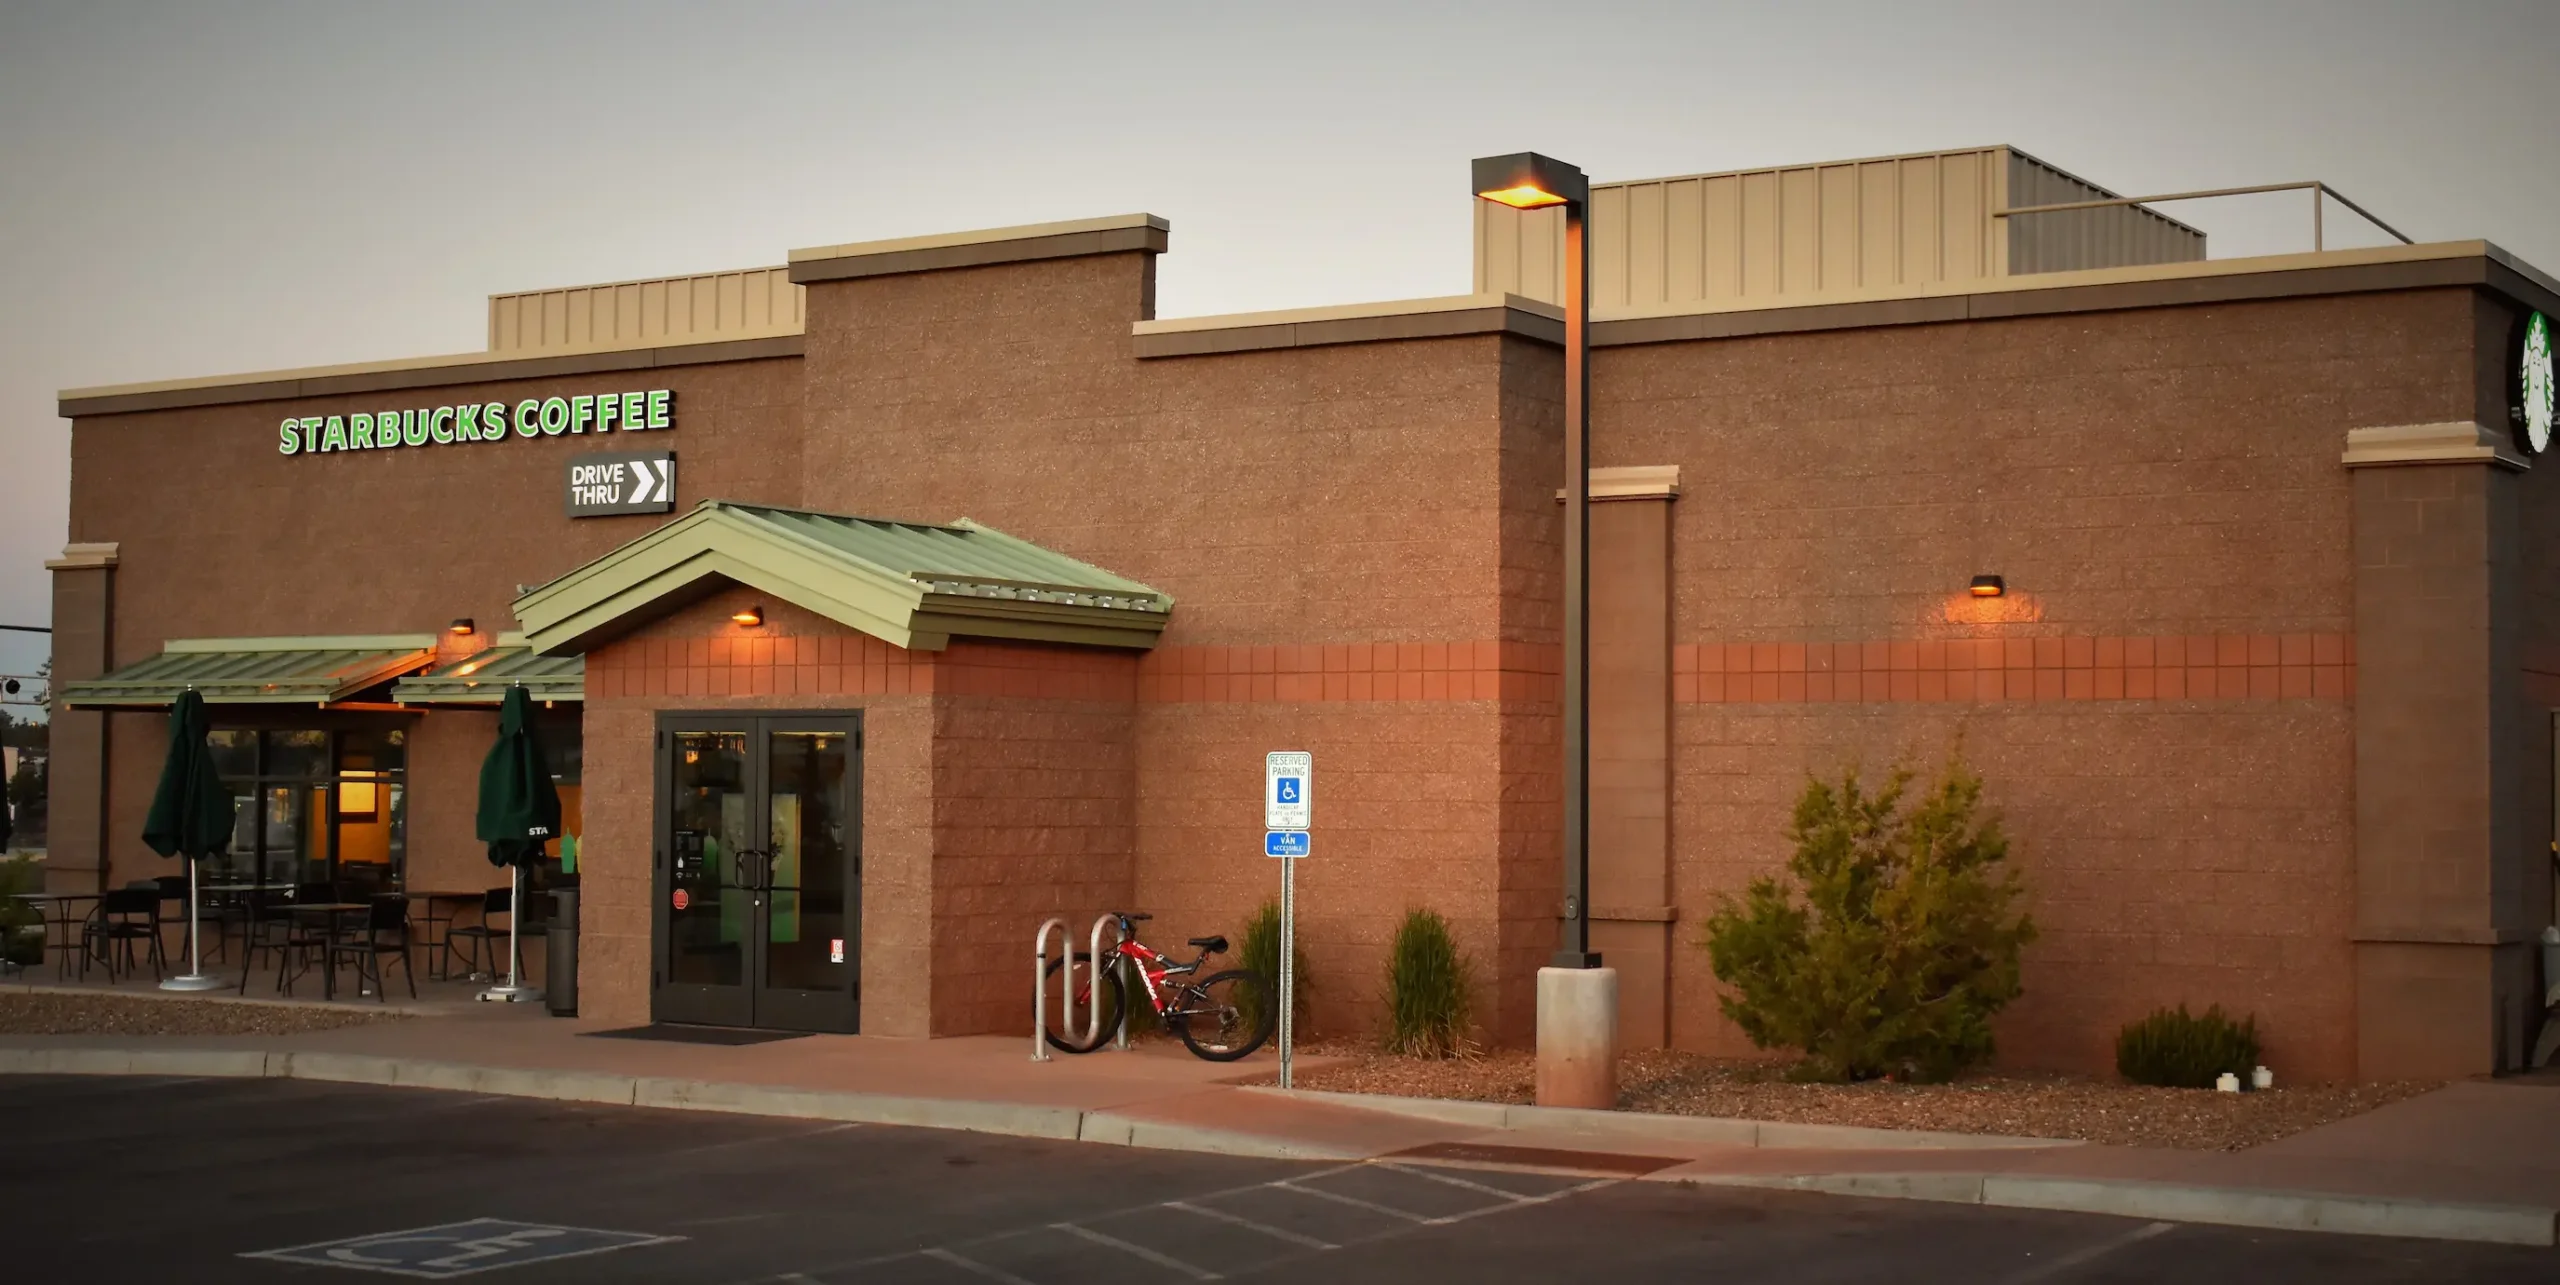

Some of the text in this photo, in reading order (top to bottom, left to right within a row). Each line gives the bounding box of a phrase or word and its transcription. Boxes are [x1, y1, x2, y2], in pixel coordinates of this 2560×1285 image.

[279, 389, 672, 454] STARBUCKS COFFEE
[571, 463, 625, 485] DRIVE
[572, 484, 620, 505] THRU
[1270, 756, 1308, 766] RESERVED
[1272, 767, 1306, 776] PARKING
[528, 826, 549, 836] STA
[1280, 836, 1296, 845] VAN
